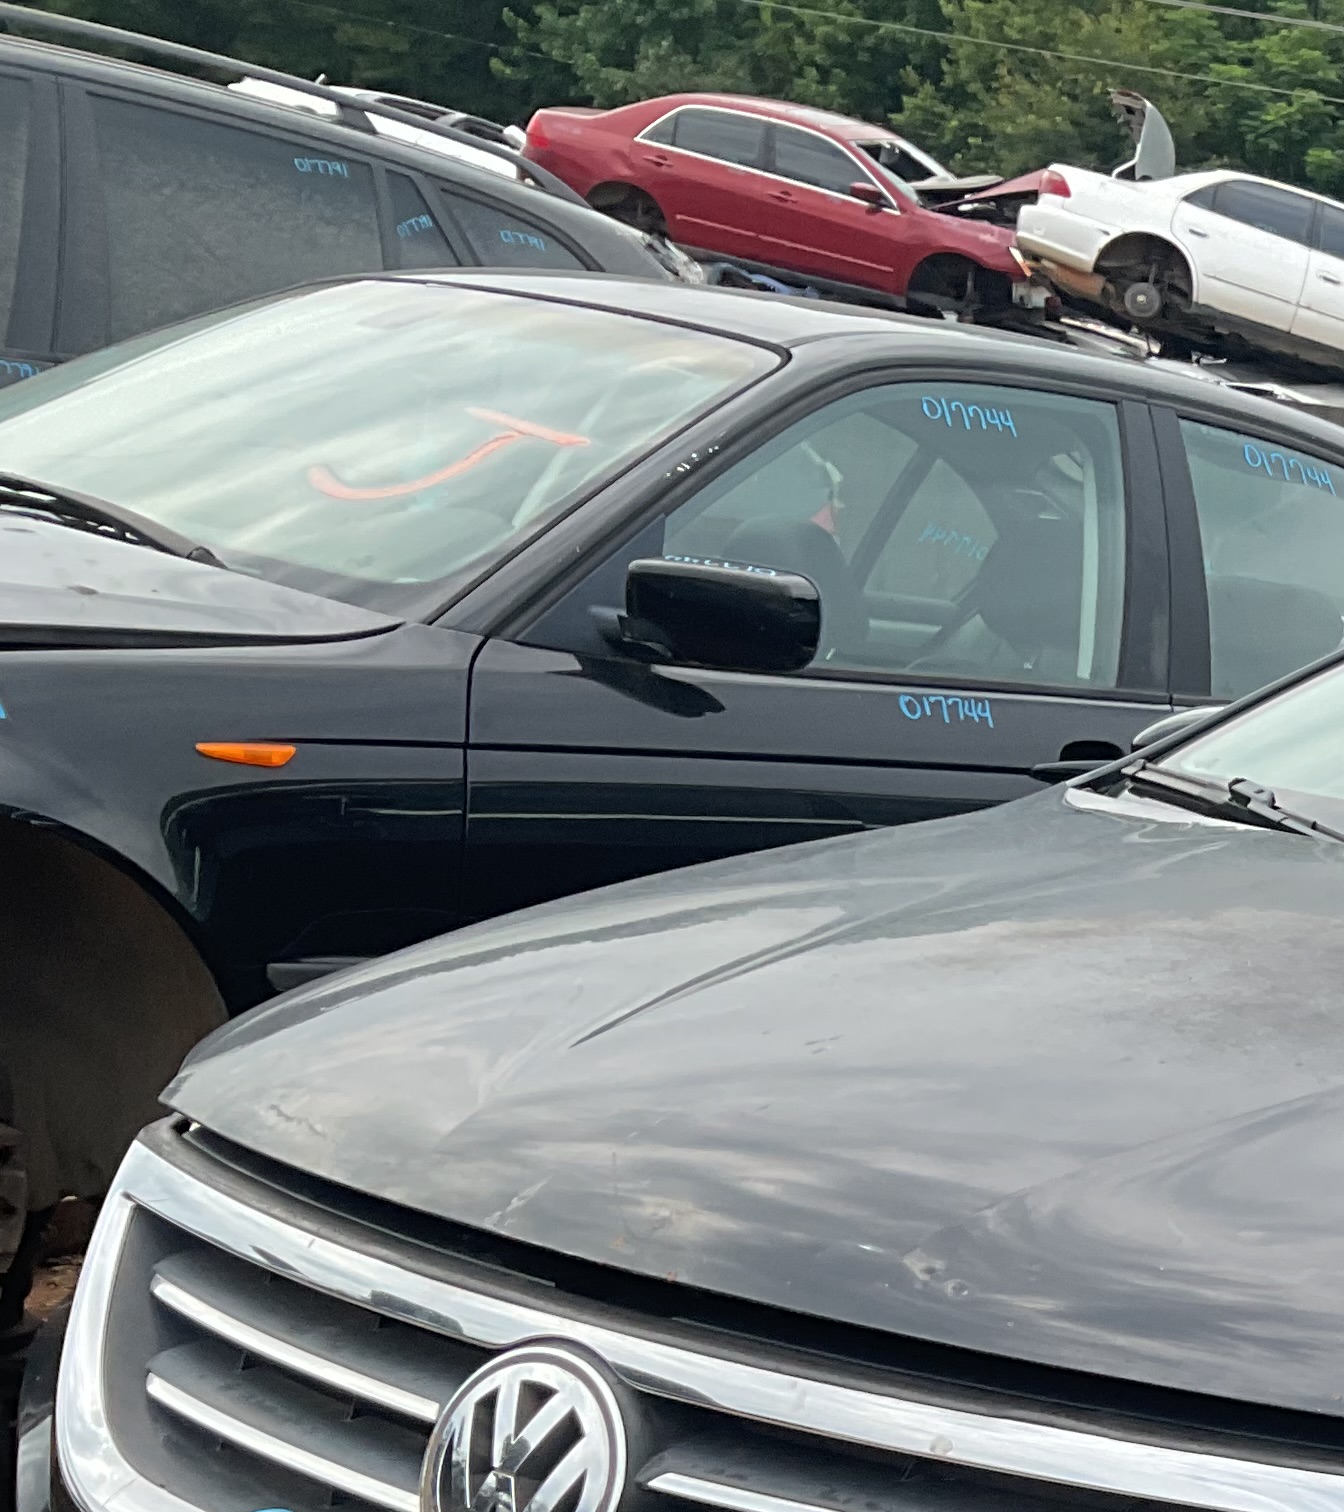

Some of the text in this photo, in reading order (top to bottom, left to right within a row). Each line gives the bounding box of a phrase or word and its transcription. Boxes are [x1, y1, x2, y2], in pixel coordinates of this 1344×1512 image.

[920, 394, 1018, 438] 017744
[1242, 441, 1337, 497] 017744
[899, 693, 995, 729] 017744
